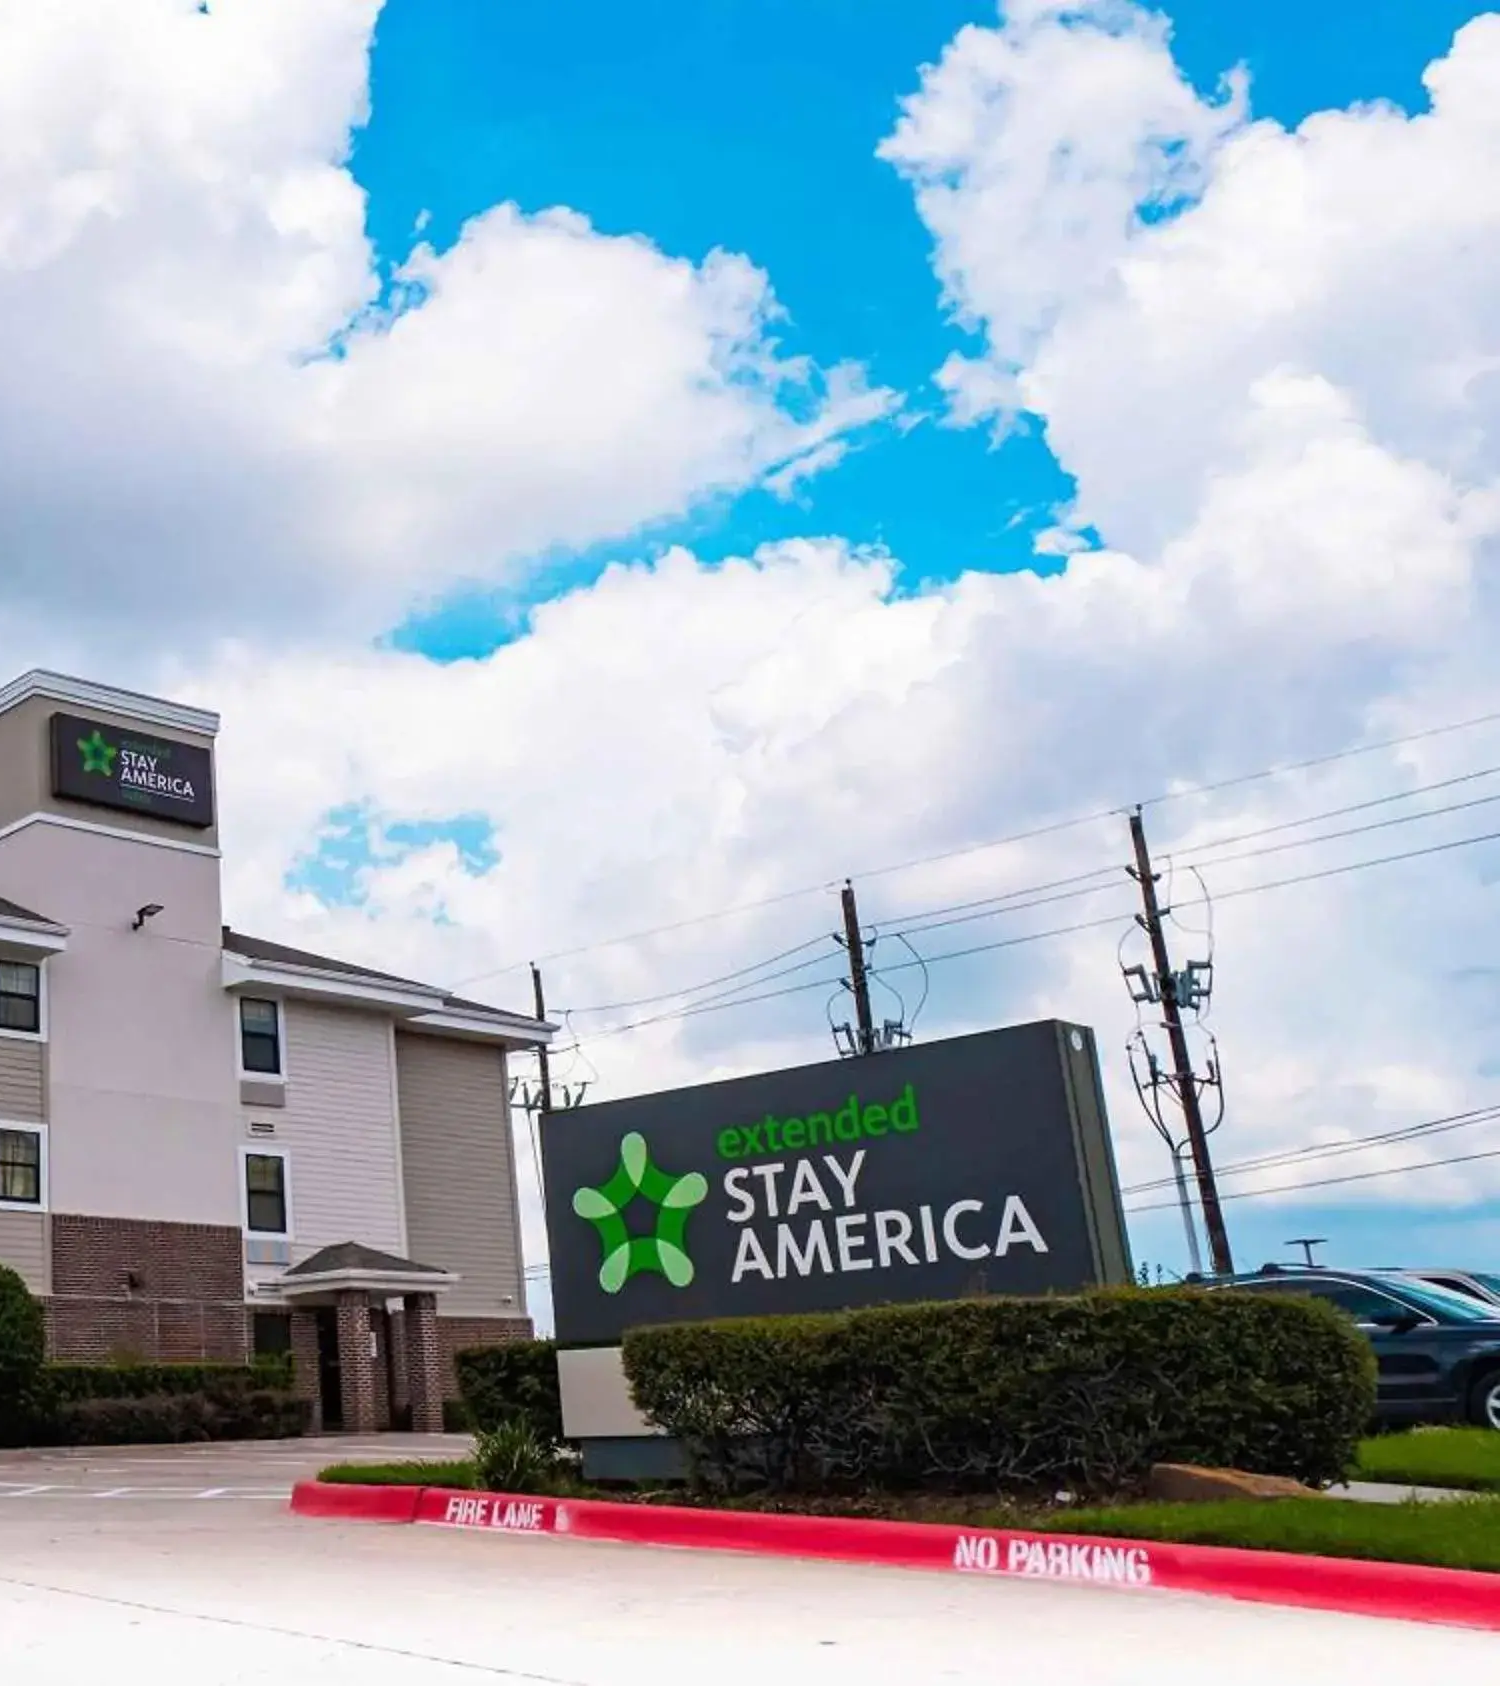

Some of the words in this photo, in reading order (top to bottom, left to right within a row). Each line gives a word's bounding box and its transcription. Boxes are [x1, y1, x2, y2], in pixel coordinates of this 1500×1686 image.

[120, 749, 158, 772] STAY
[120, 767, 195, 797] AMERICA
[717, 1083, 919, 1158] extended
[724, 1150, 866, 1222] STAY
[731, 1196, 1049, 1283] AMERICA
[445, 1497, 488, 1525] FIRE
[491, 1501, 543, 1529] LANE
[954, 1536, 998, 1569] NO
[1008, 1540, 1152, 1585] PARKING
